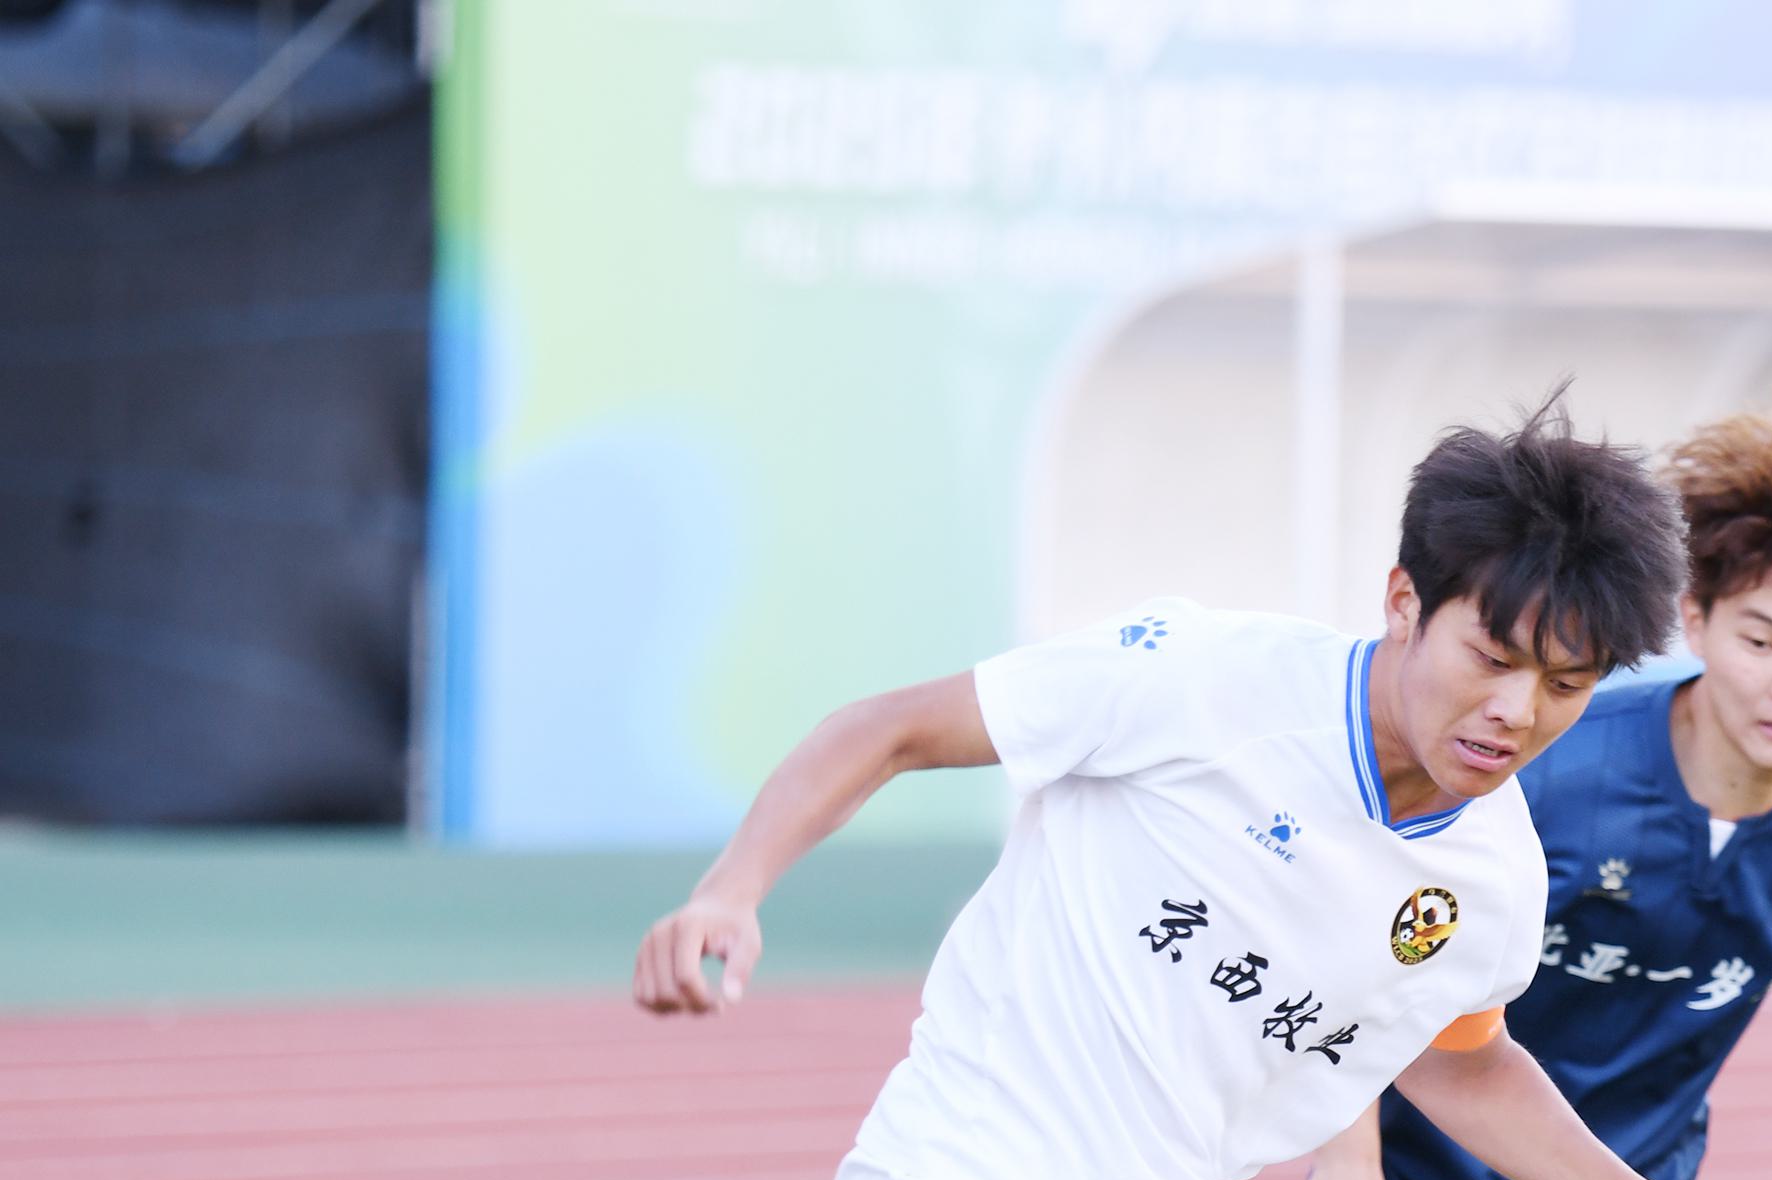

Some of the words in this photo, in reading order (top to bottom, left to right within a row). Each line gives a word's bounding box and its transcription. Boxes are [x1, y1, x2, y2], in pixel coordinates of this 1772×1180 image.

[1244, 824, 1297, 864] KELME
[1138, 898, 1360, 1066] 京西牧业
